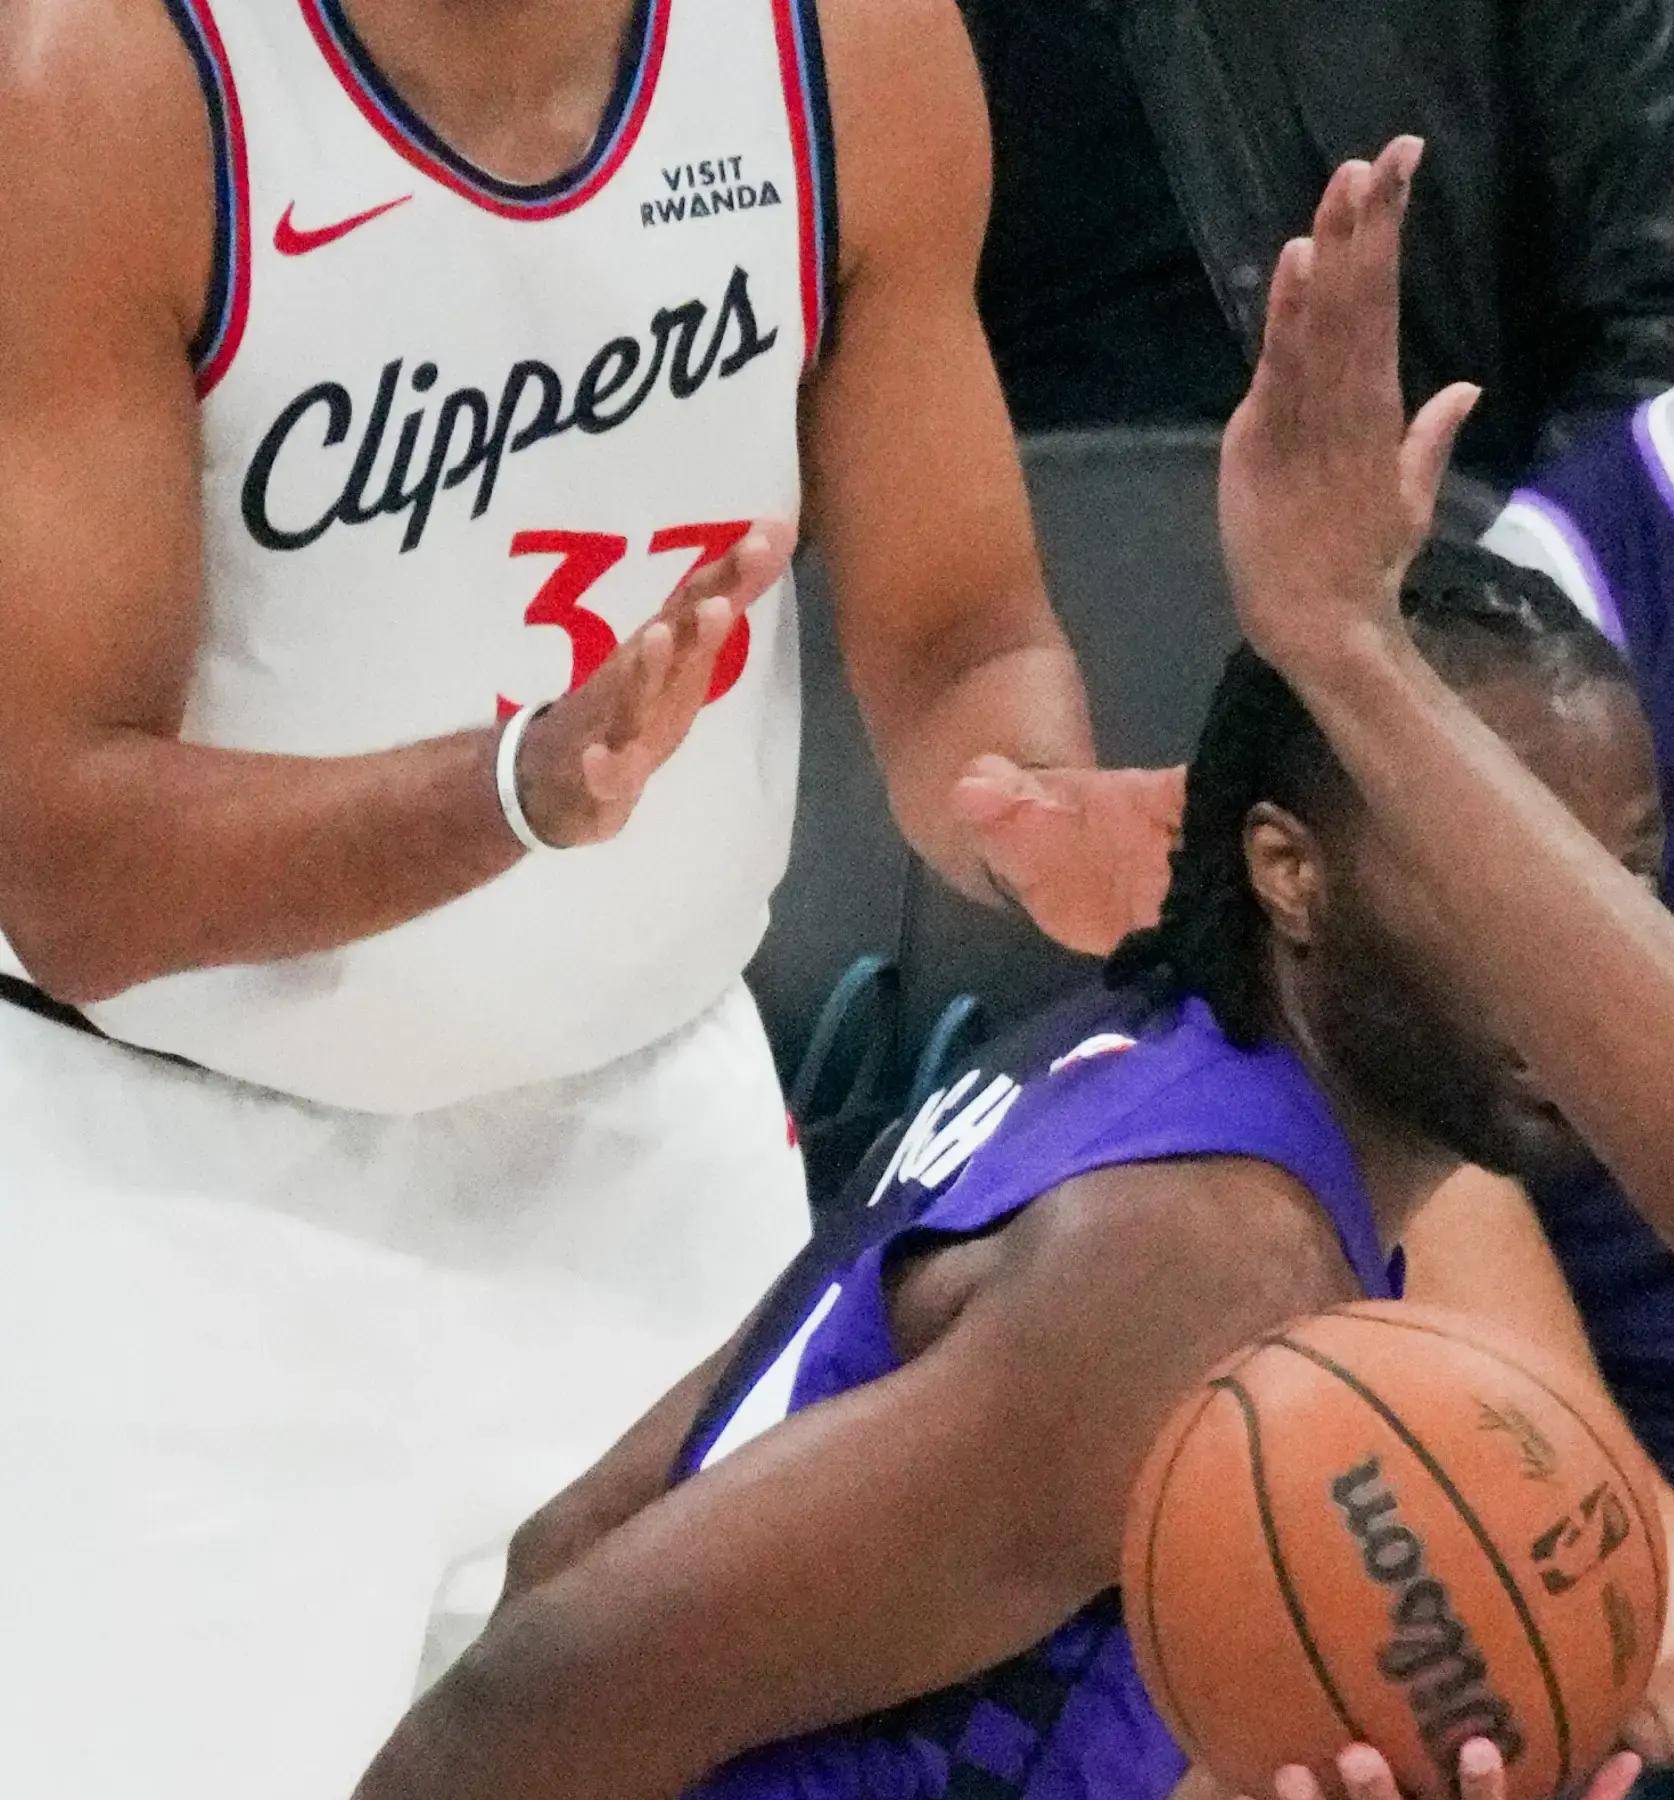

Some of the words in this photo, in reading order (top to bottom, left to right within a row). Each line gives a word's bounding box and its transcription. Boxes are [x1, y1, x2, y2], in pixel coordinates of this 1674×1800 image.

[661, 154, 743, 191] VISIT
[640, 180, 782, 228] RWANDA
[241, 266, 778, 553] Clippers
